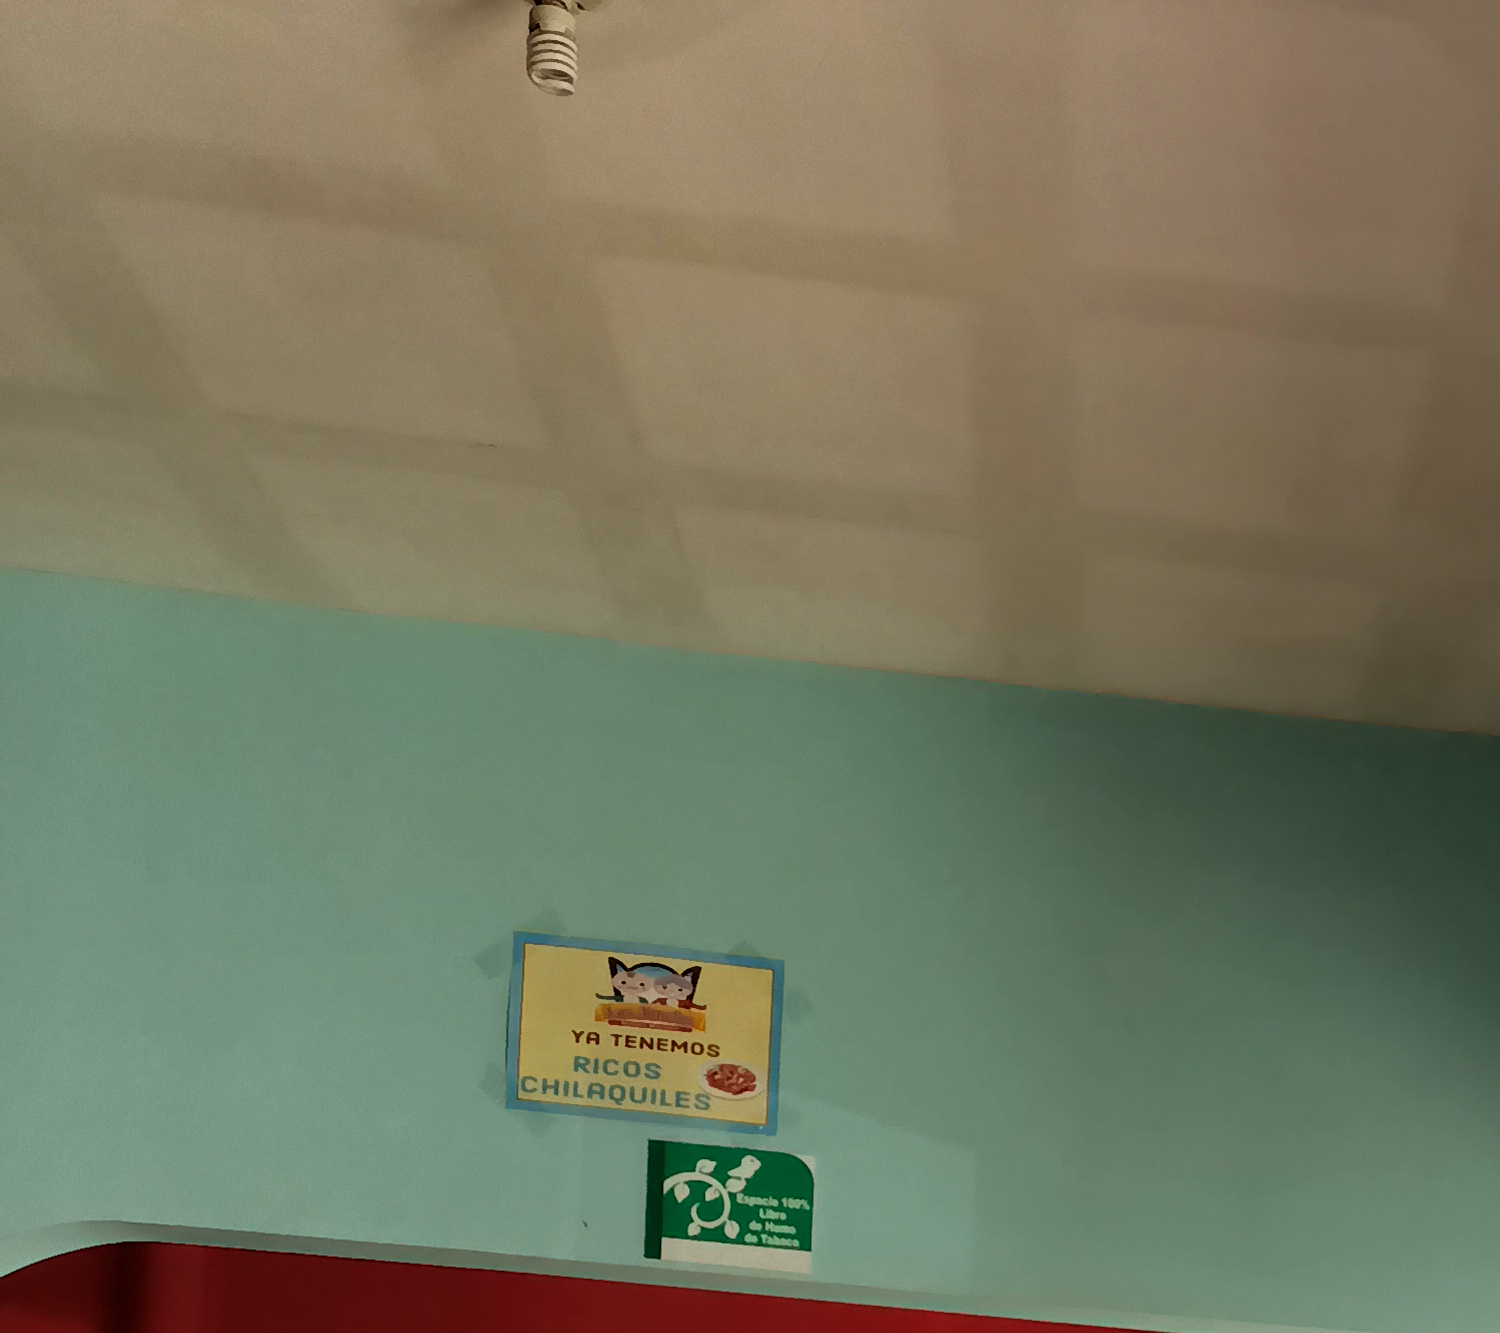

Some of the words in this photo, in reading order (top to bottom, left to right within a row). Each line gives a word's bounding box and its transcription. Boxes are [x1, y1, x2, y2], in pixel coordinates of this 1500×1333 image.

[570, 1029, 600, 1045] YA
[610, 1034, 721, 1057] TENEMOS
[574, 1055, 662, 1080] RICOS
[521, 1075, 711, 1111] CHILAQUILES
